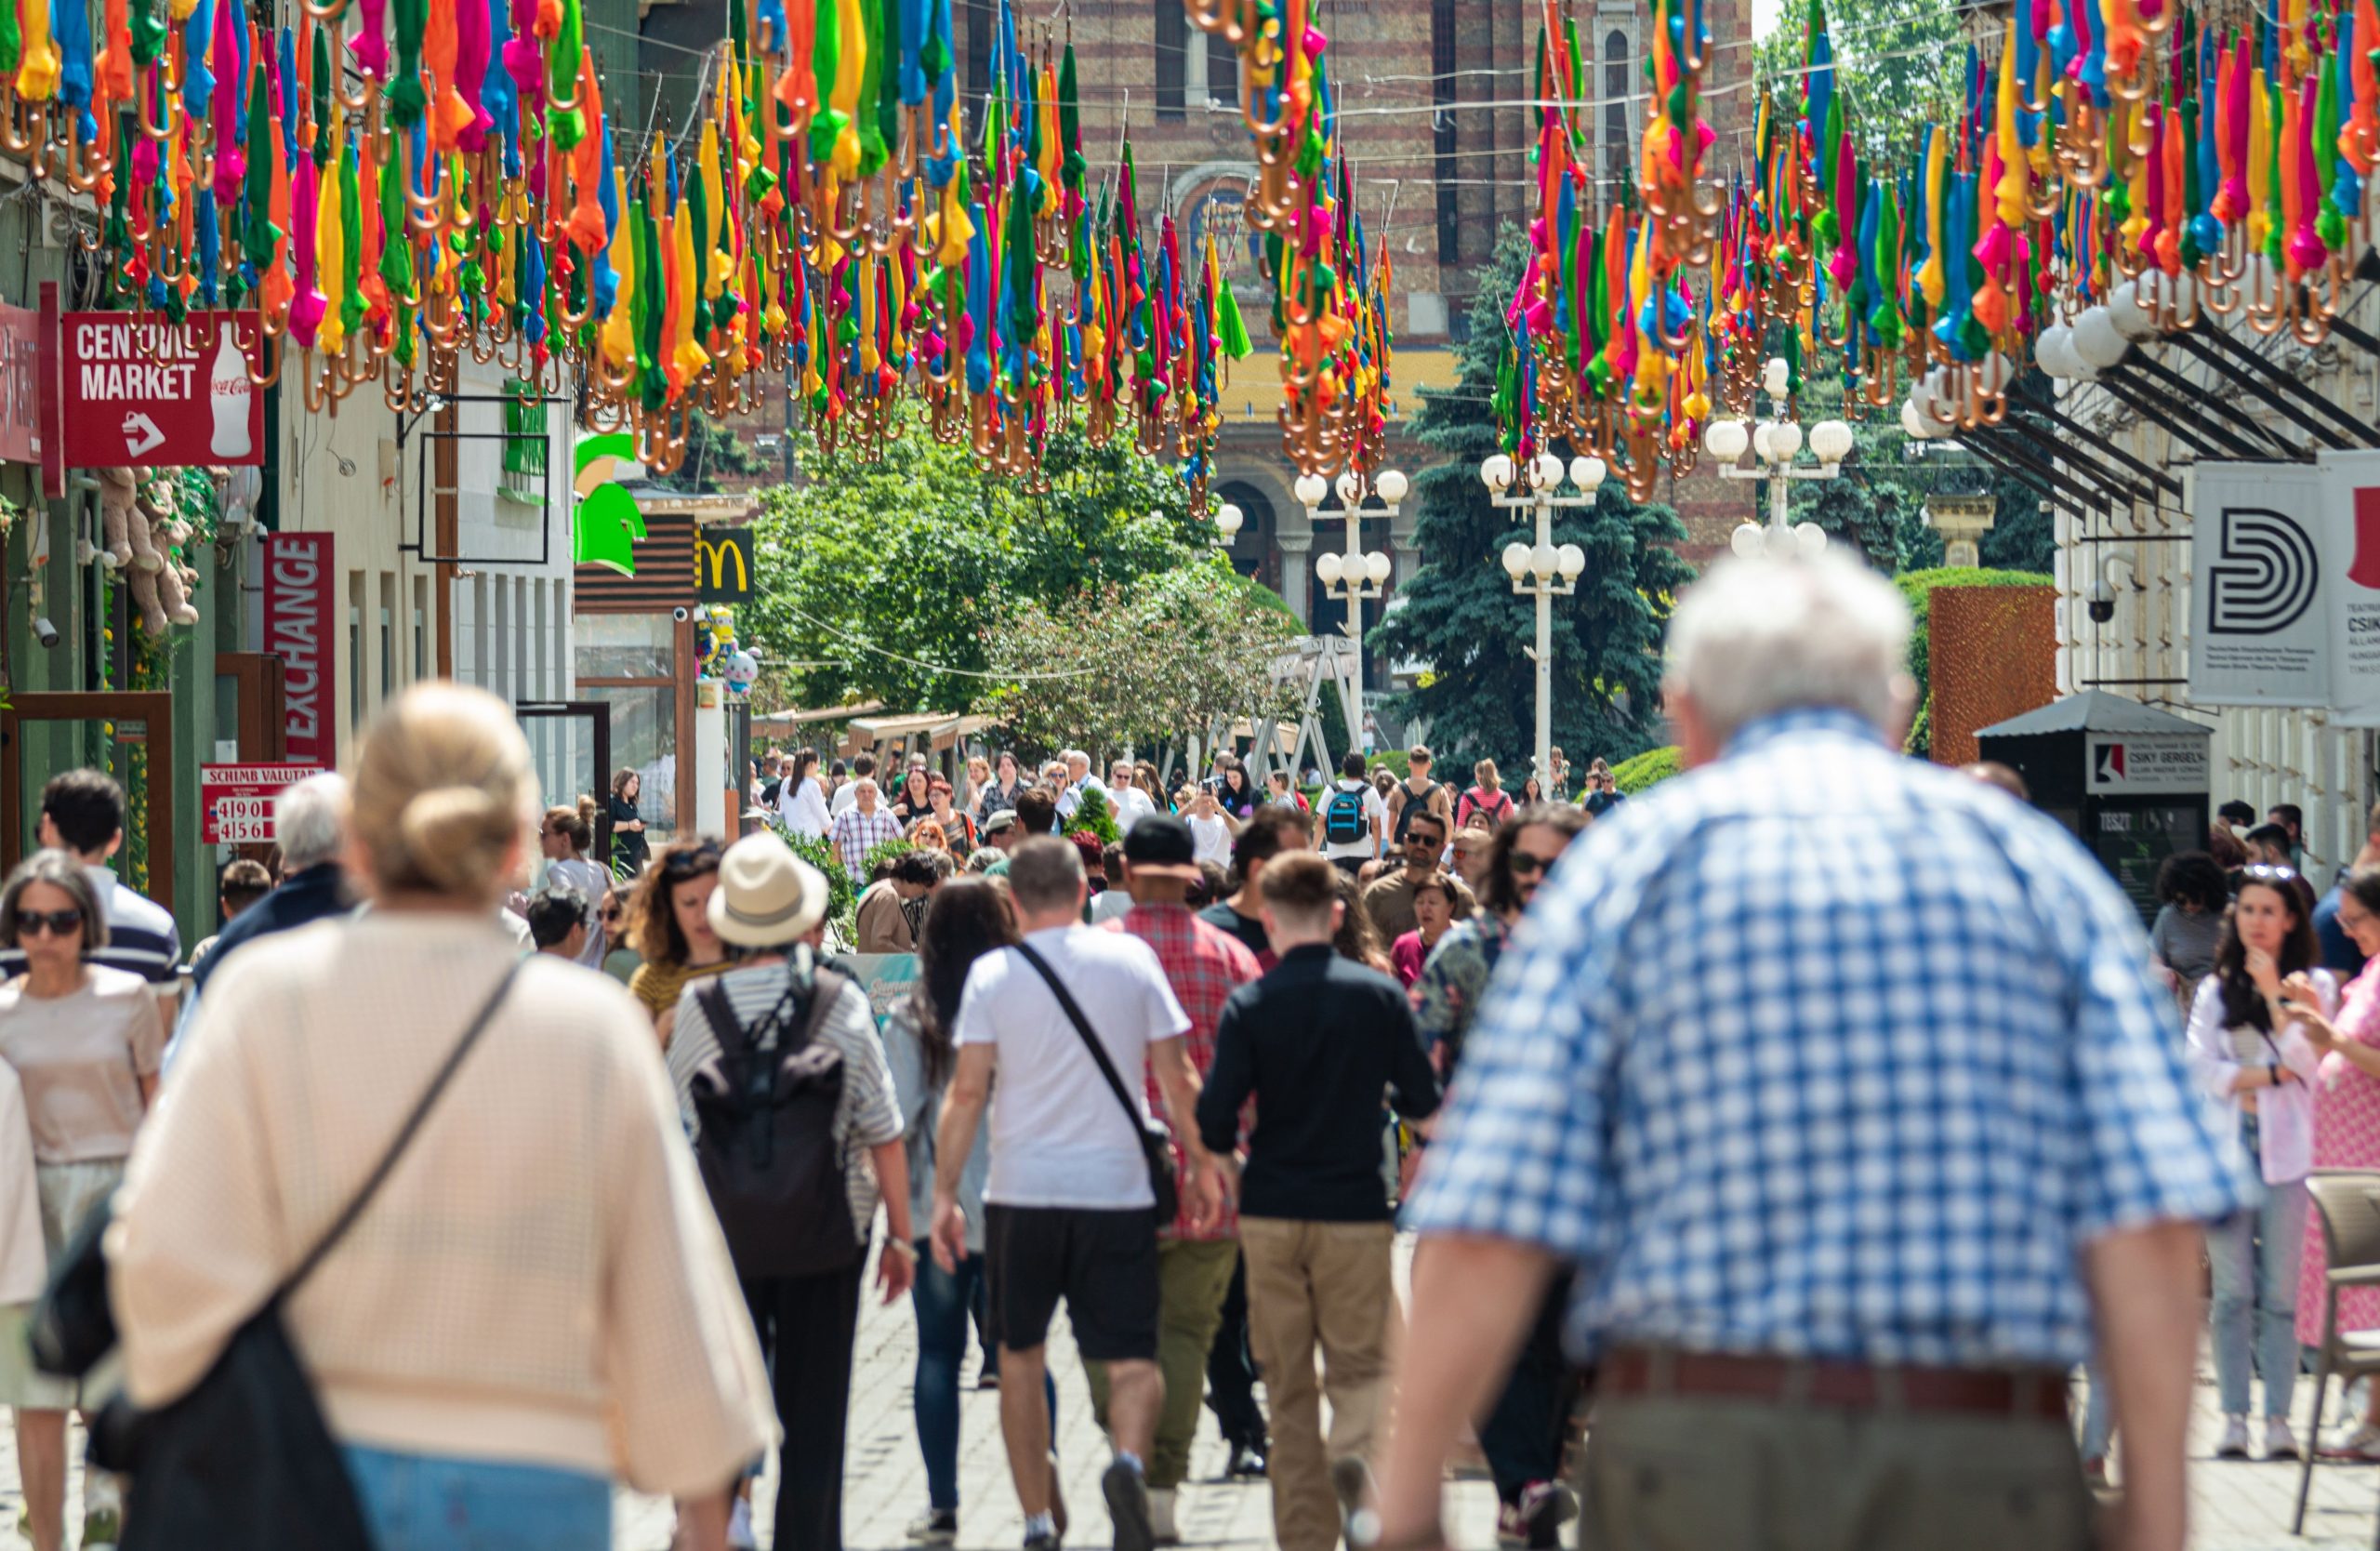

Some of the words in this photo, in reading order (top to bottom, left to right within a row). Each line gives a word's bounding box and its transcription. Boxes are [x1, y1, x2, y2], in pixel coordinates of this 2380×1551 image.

[77, 324, 200, 360] CENTRAL
[81, 364, 196, 401] MARKET
[273, 539, 319, 739] EXCHANGE
[209, 770, 258, 782] SCHIMB
